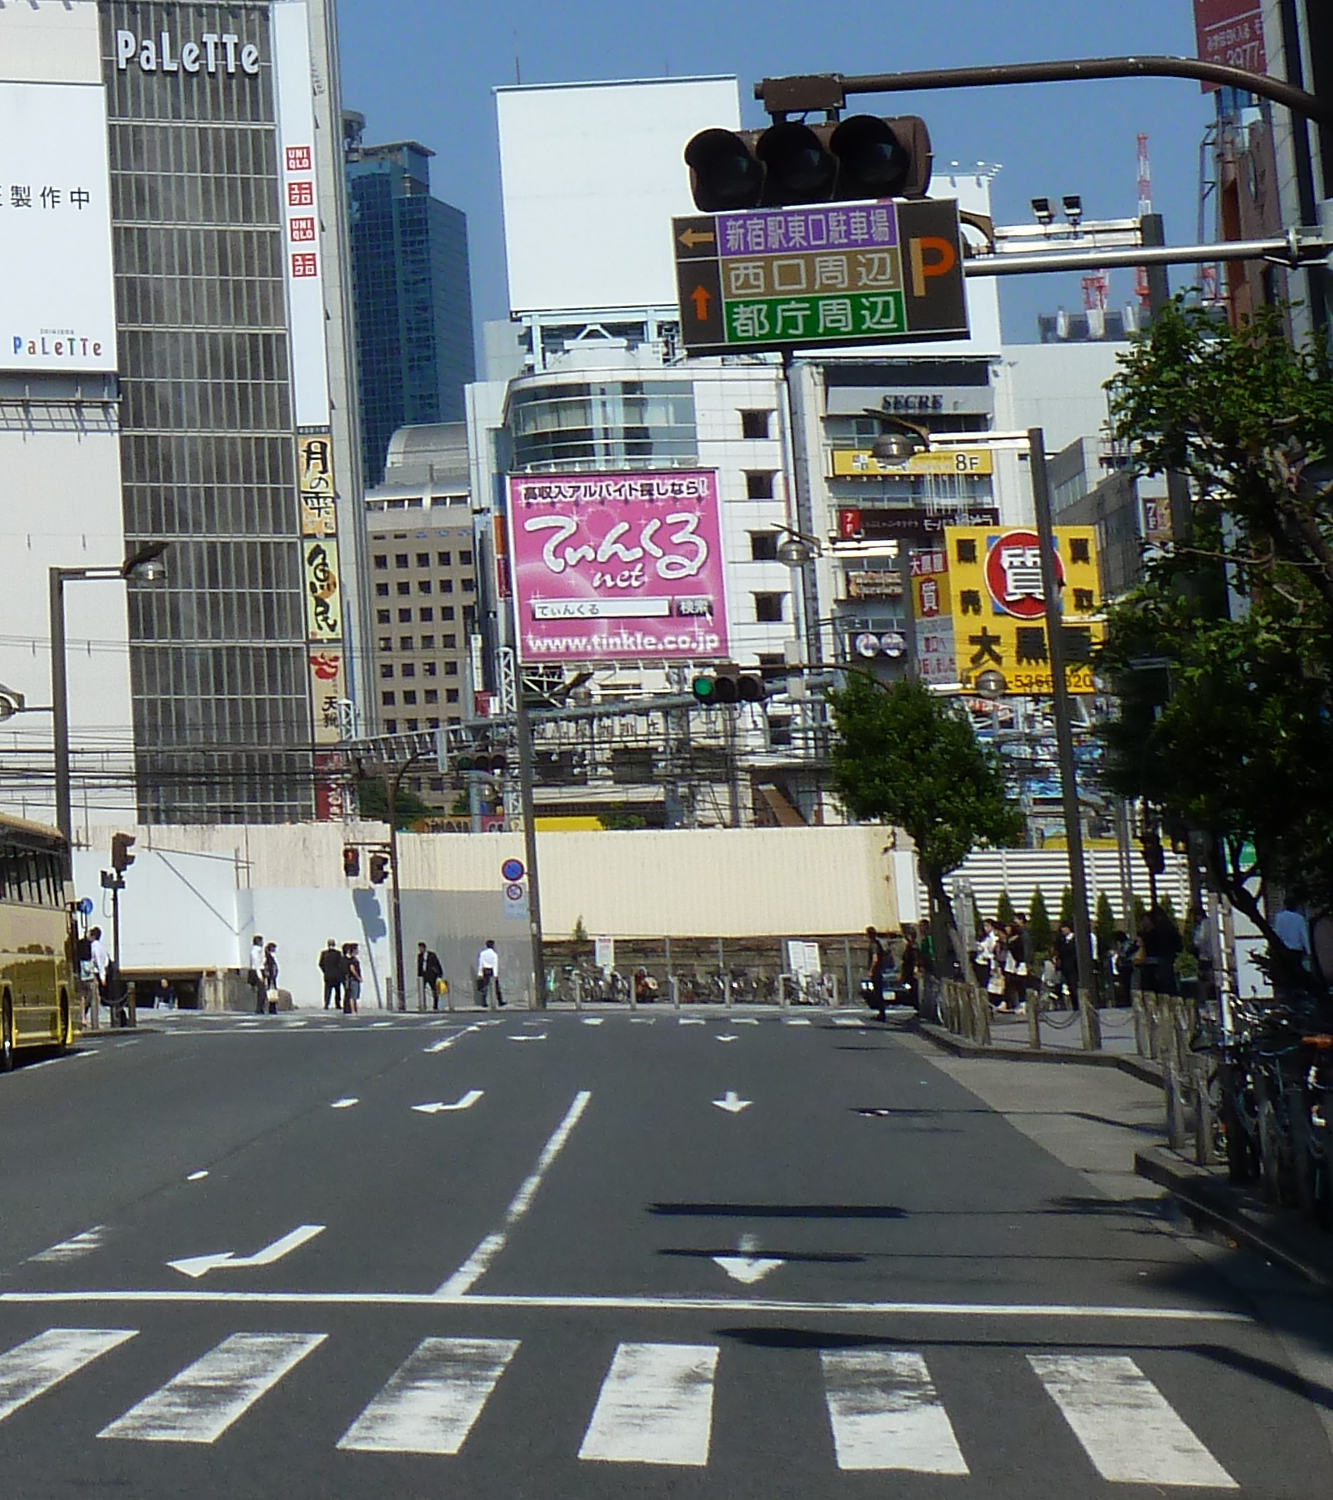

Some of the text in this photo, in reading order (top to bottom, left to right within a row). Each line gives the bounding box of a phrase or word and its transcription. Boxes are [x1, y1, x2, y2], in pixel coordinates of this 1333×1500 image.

[726, 208, 890, 252] 新宿駅東口駐車場
[728, 252, 895, 295] 西口周辺
[909, 235, 956, 297] P
[731, 296, 898, 338] 都庁周辺
[954, 453, 980, 472] 8F
[591, 562, 645, 589] net
[527, 629, 720, 652] www.tinkle.co.jp
